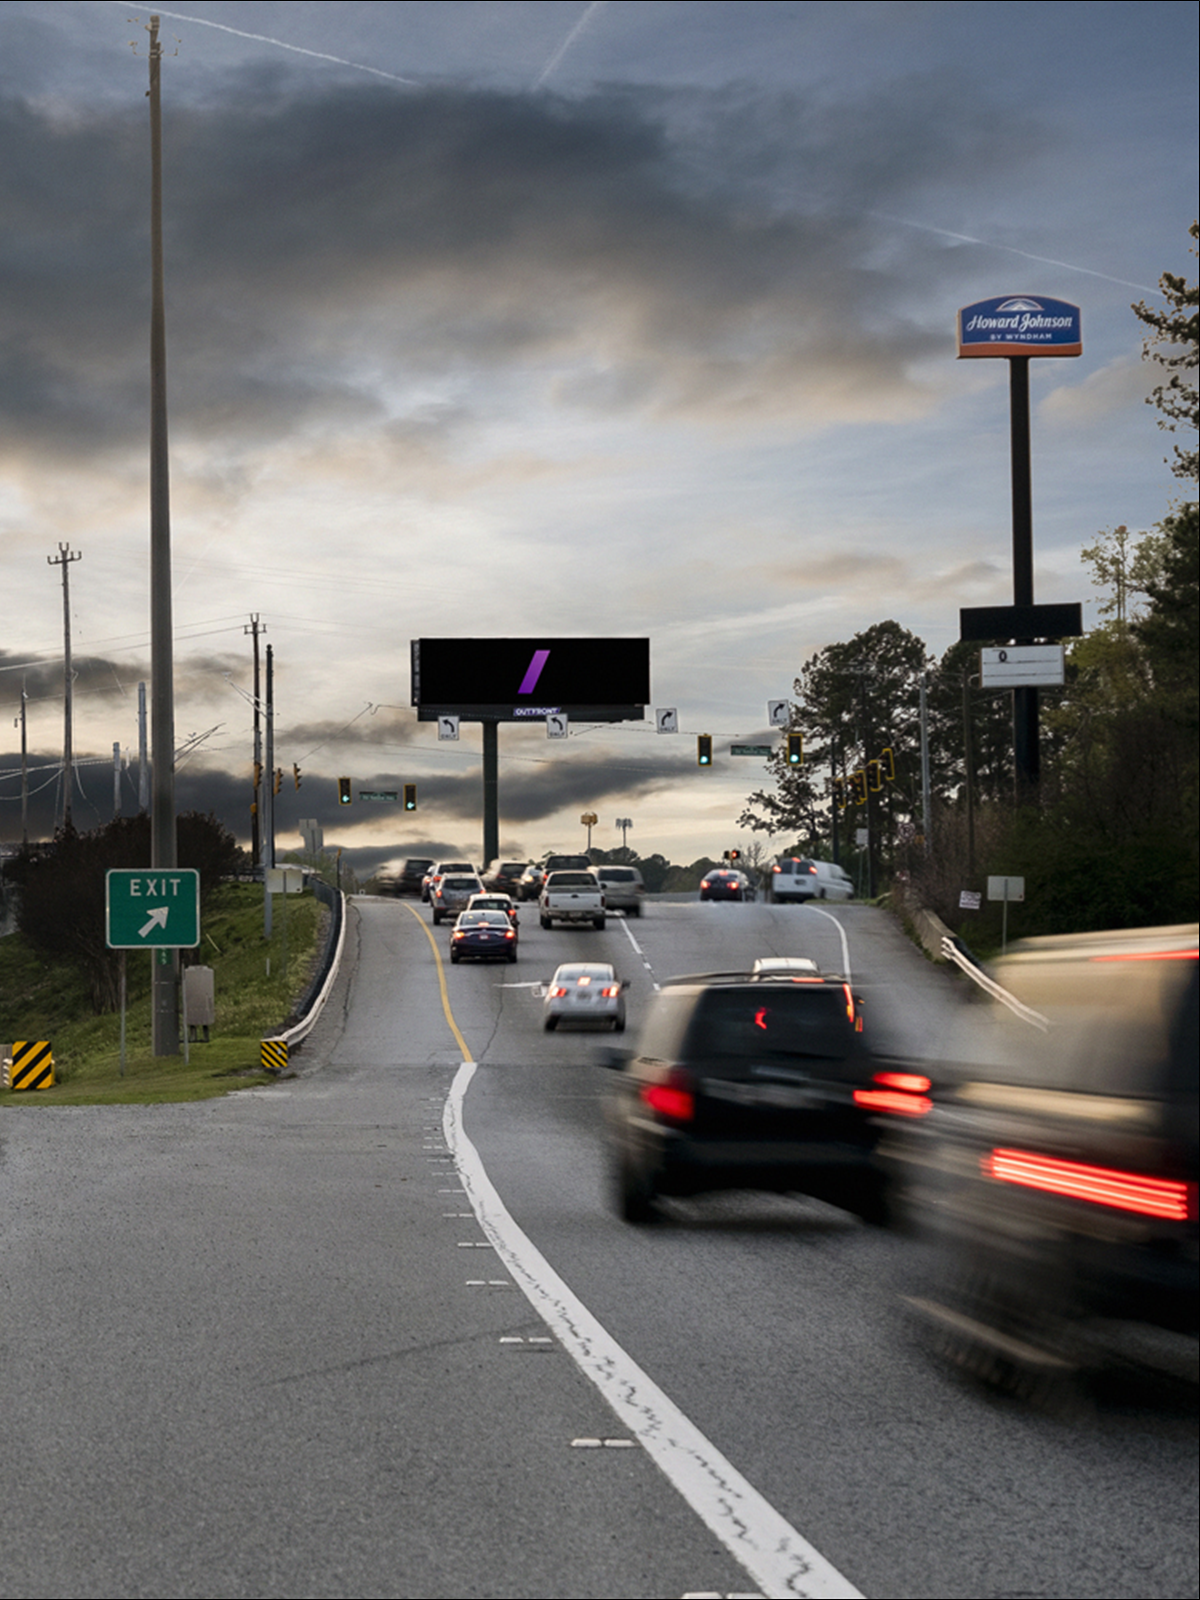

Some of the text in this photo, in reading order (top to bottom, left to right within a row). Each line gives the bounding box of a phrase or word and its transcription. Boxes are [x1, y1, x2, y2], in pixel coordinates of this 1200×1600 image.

[966, 313, 1073, 332] Howard Johnson
[990, 333, 1002, 341] BY
[515, 707, 558, 716] OUTFRONT
[130, 879, 181, 896] EXIT
